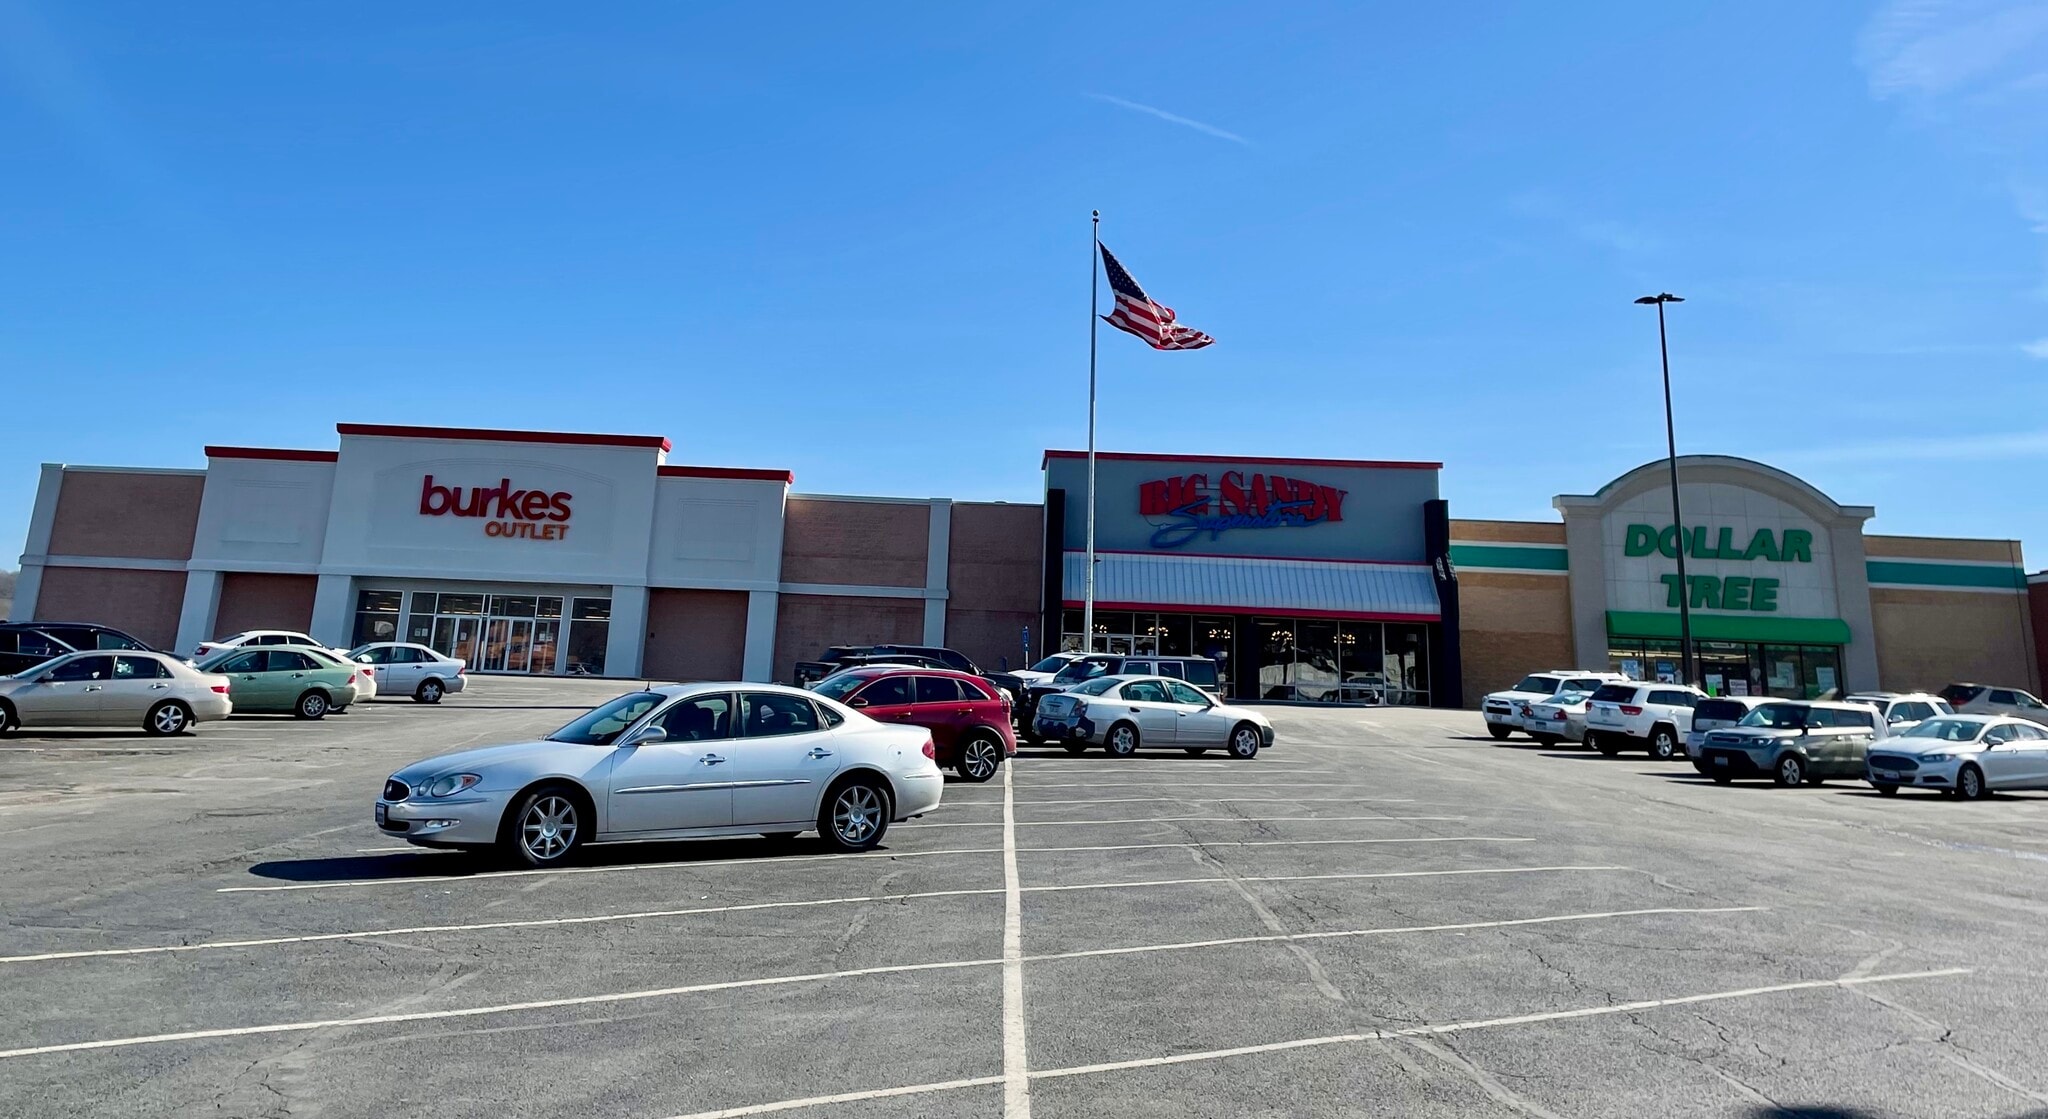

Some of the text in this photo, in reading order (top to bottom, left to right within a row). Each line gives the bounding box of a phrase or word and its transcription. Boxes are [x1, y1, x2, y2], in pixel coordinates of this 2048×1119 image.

[420, 474, 573, 522] burkes
[1139, 470, 1349, 522] BIG SANDY
[485, 521, 569, 541] OUTLET
[1150, 495, 1327, 548] Superstore
[1624, 523, 1813, 562] DOLLAR
[1660, 573, 1780, 611] TREE
